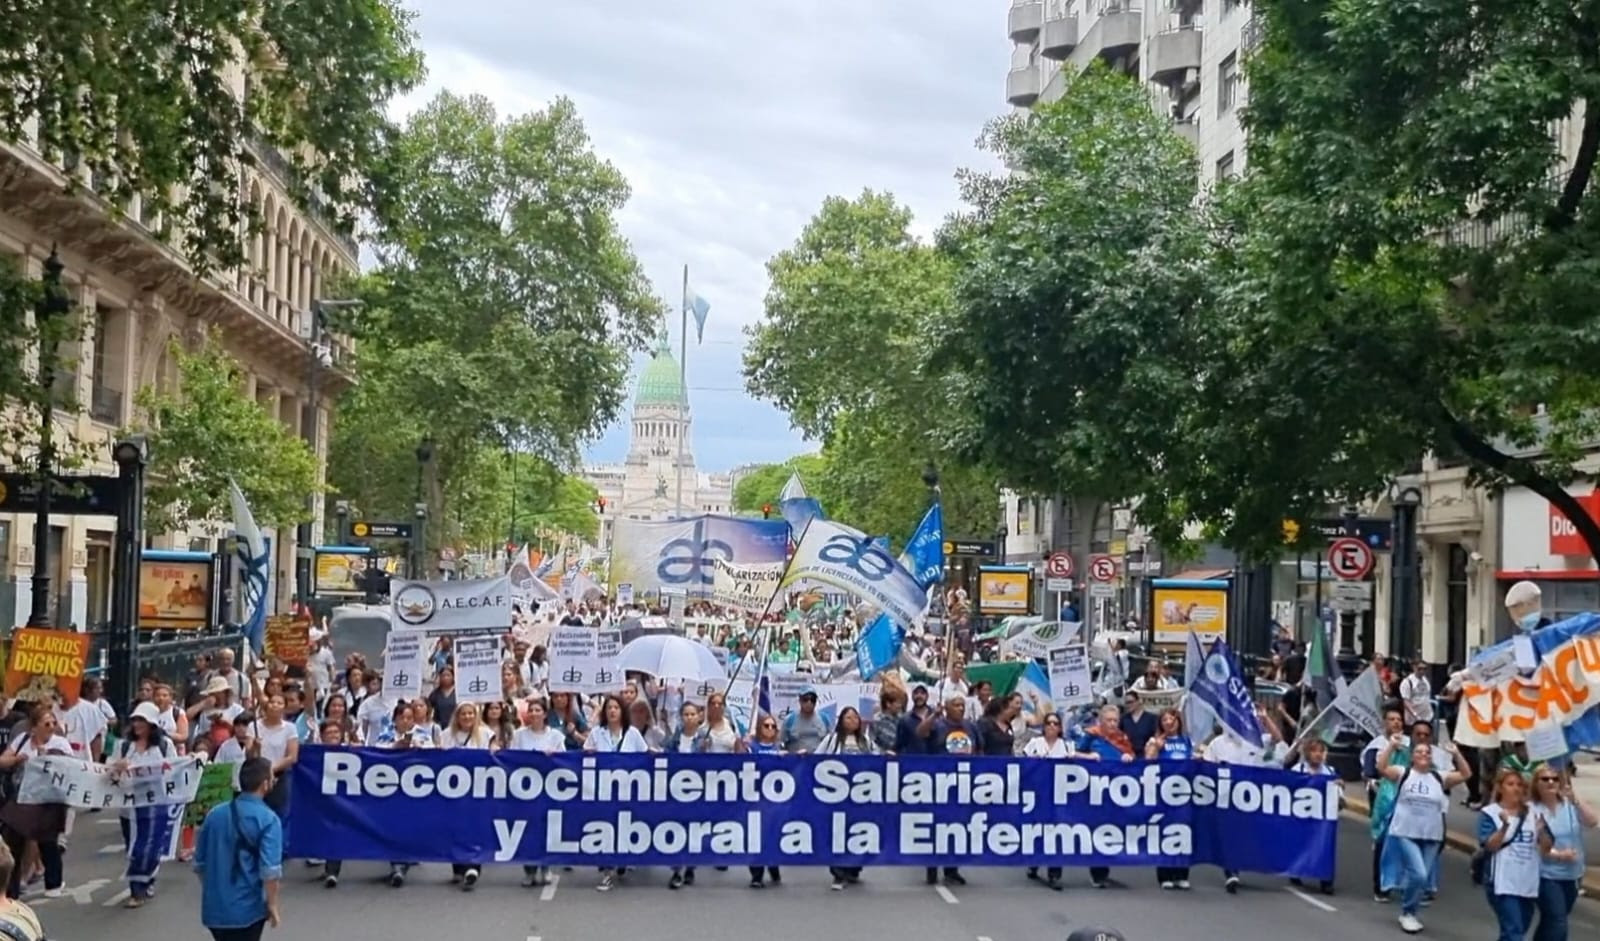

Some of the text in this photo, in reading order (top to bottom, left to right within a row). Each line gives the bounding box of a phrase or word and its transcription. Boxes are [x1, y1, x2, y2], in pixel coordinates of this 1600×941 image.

[442, 595, 507, 609] A.E.C.A.F.
[322, 752, 1339, 821] Reconocimiento Salarial, Profesional
[493, 810, 1193, 861] y Laboral a la Enfermería
